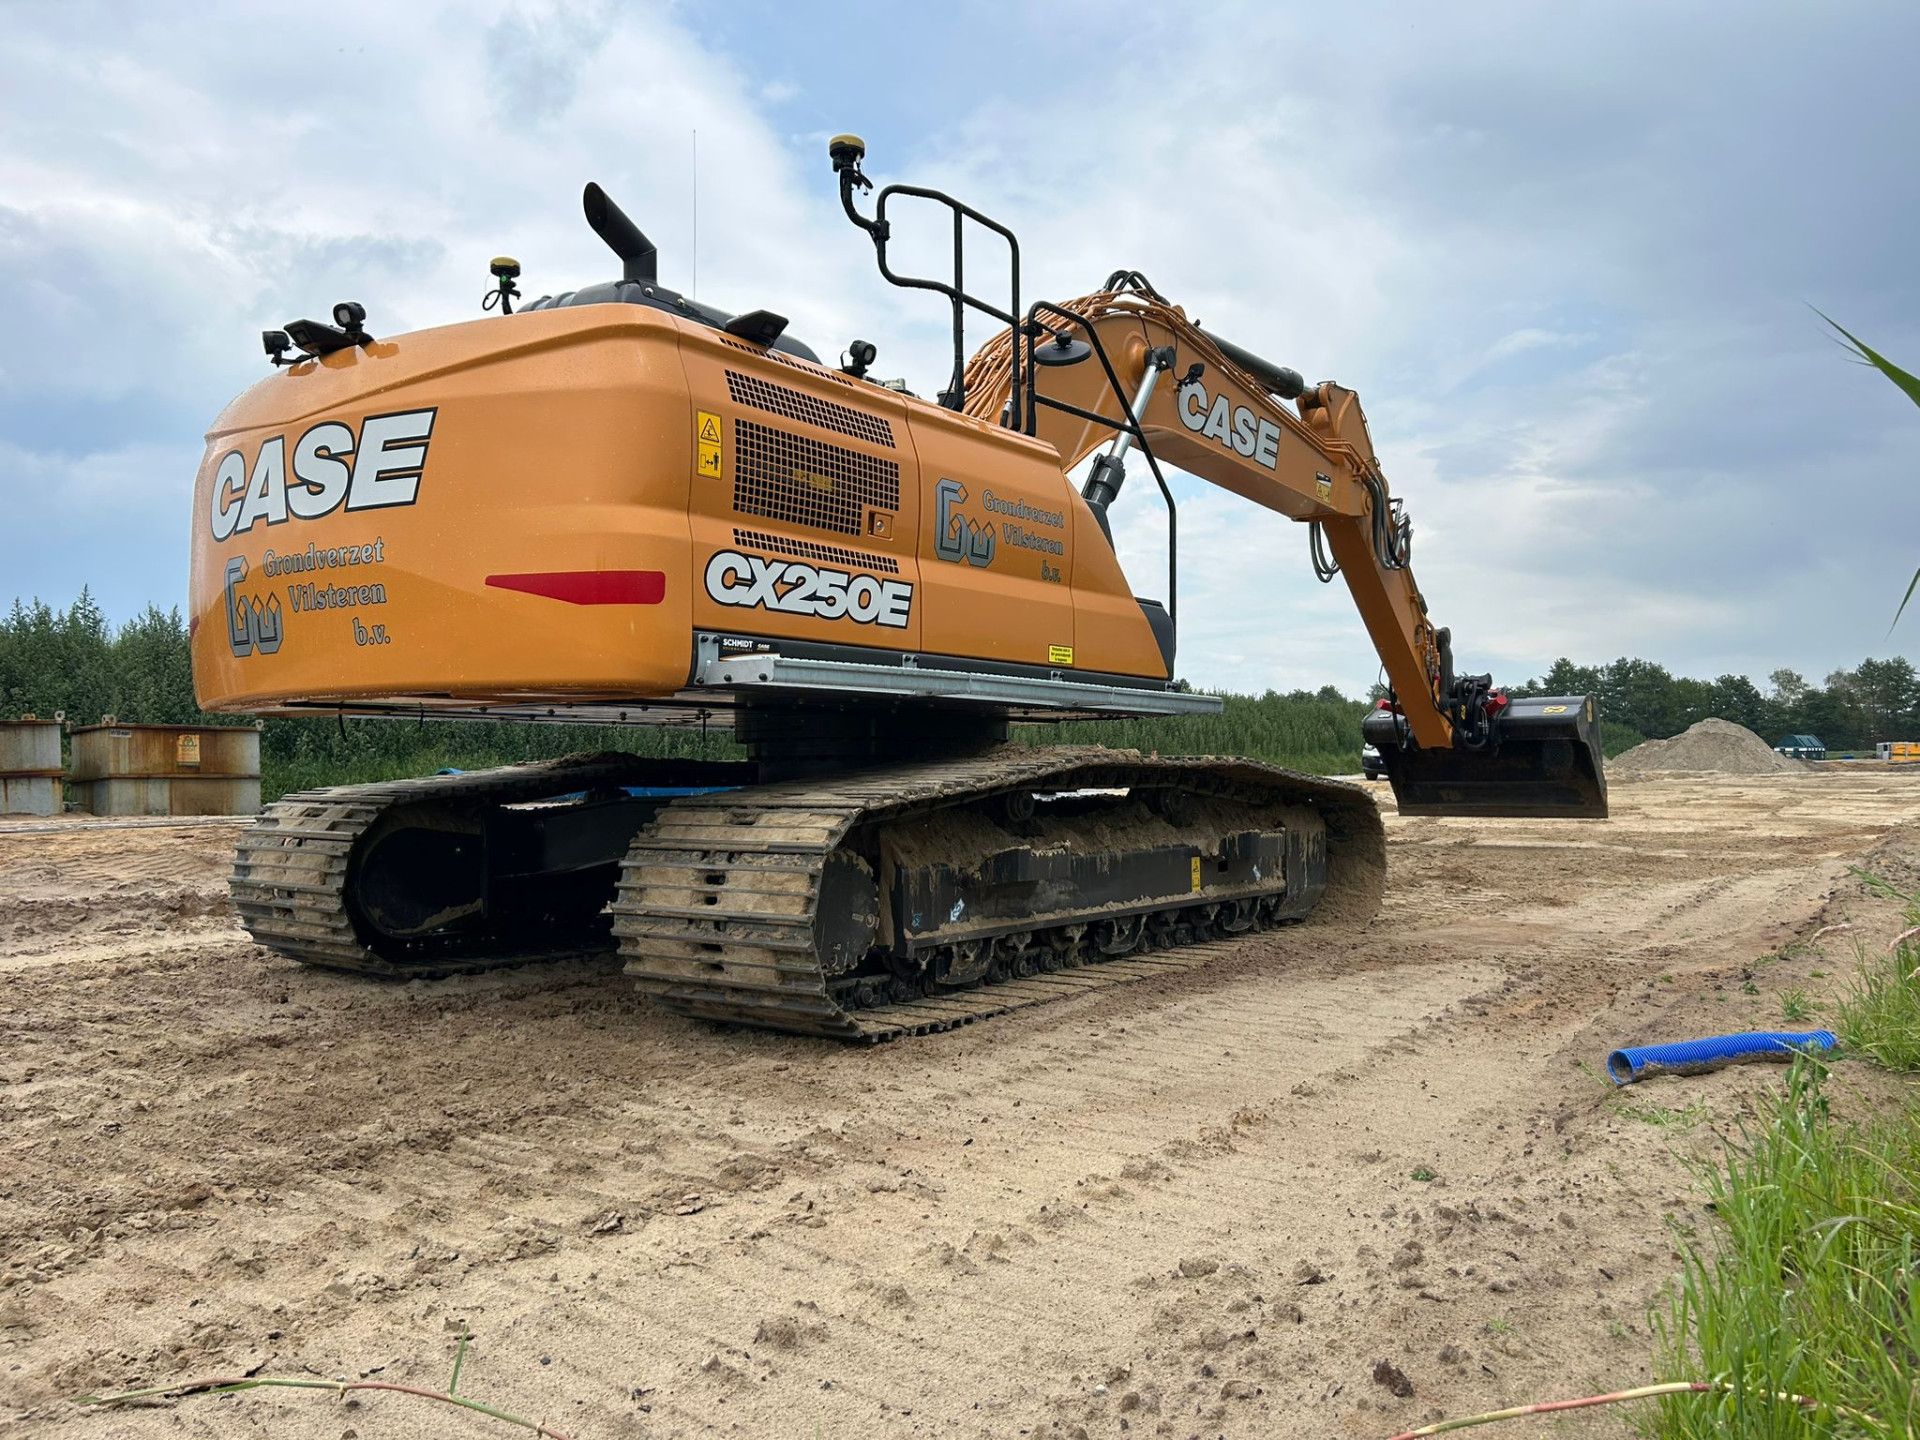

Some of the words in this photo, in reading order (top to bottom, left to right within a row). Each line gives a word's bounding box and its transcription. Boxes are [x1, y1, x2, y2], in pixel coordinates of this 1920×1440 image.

[1177, 380, 1281, 471] CASE
[210, 406, 439, 542] CASE
[982, 489, 1064, 528] Grondverzet
[263, 536, 384, 578] Grondverzet
[1003, 523, 1063, 555] Vilsteren
[287, 582, 387, 613] Vilsteren
[704, 549, 914, 629] CX250E
[352, 617, 391, 646] b.v.
[723, 638, 753, 648] SCHMIDT
